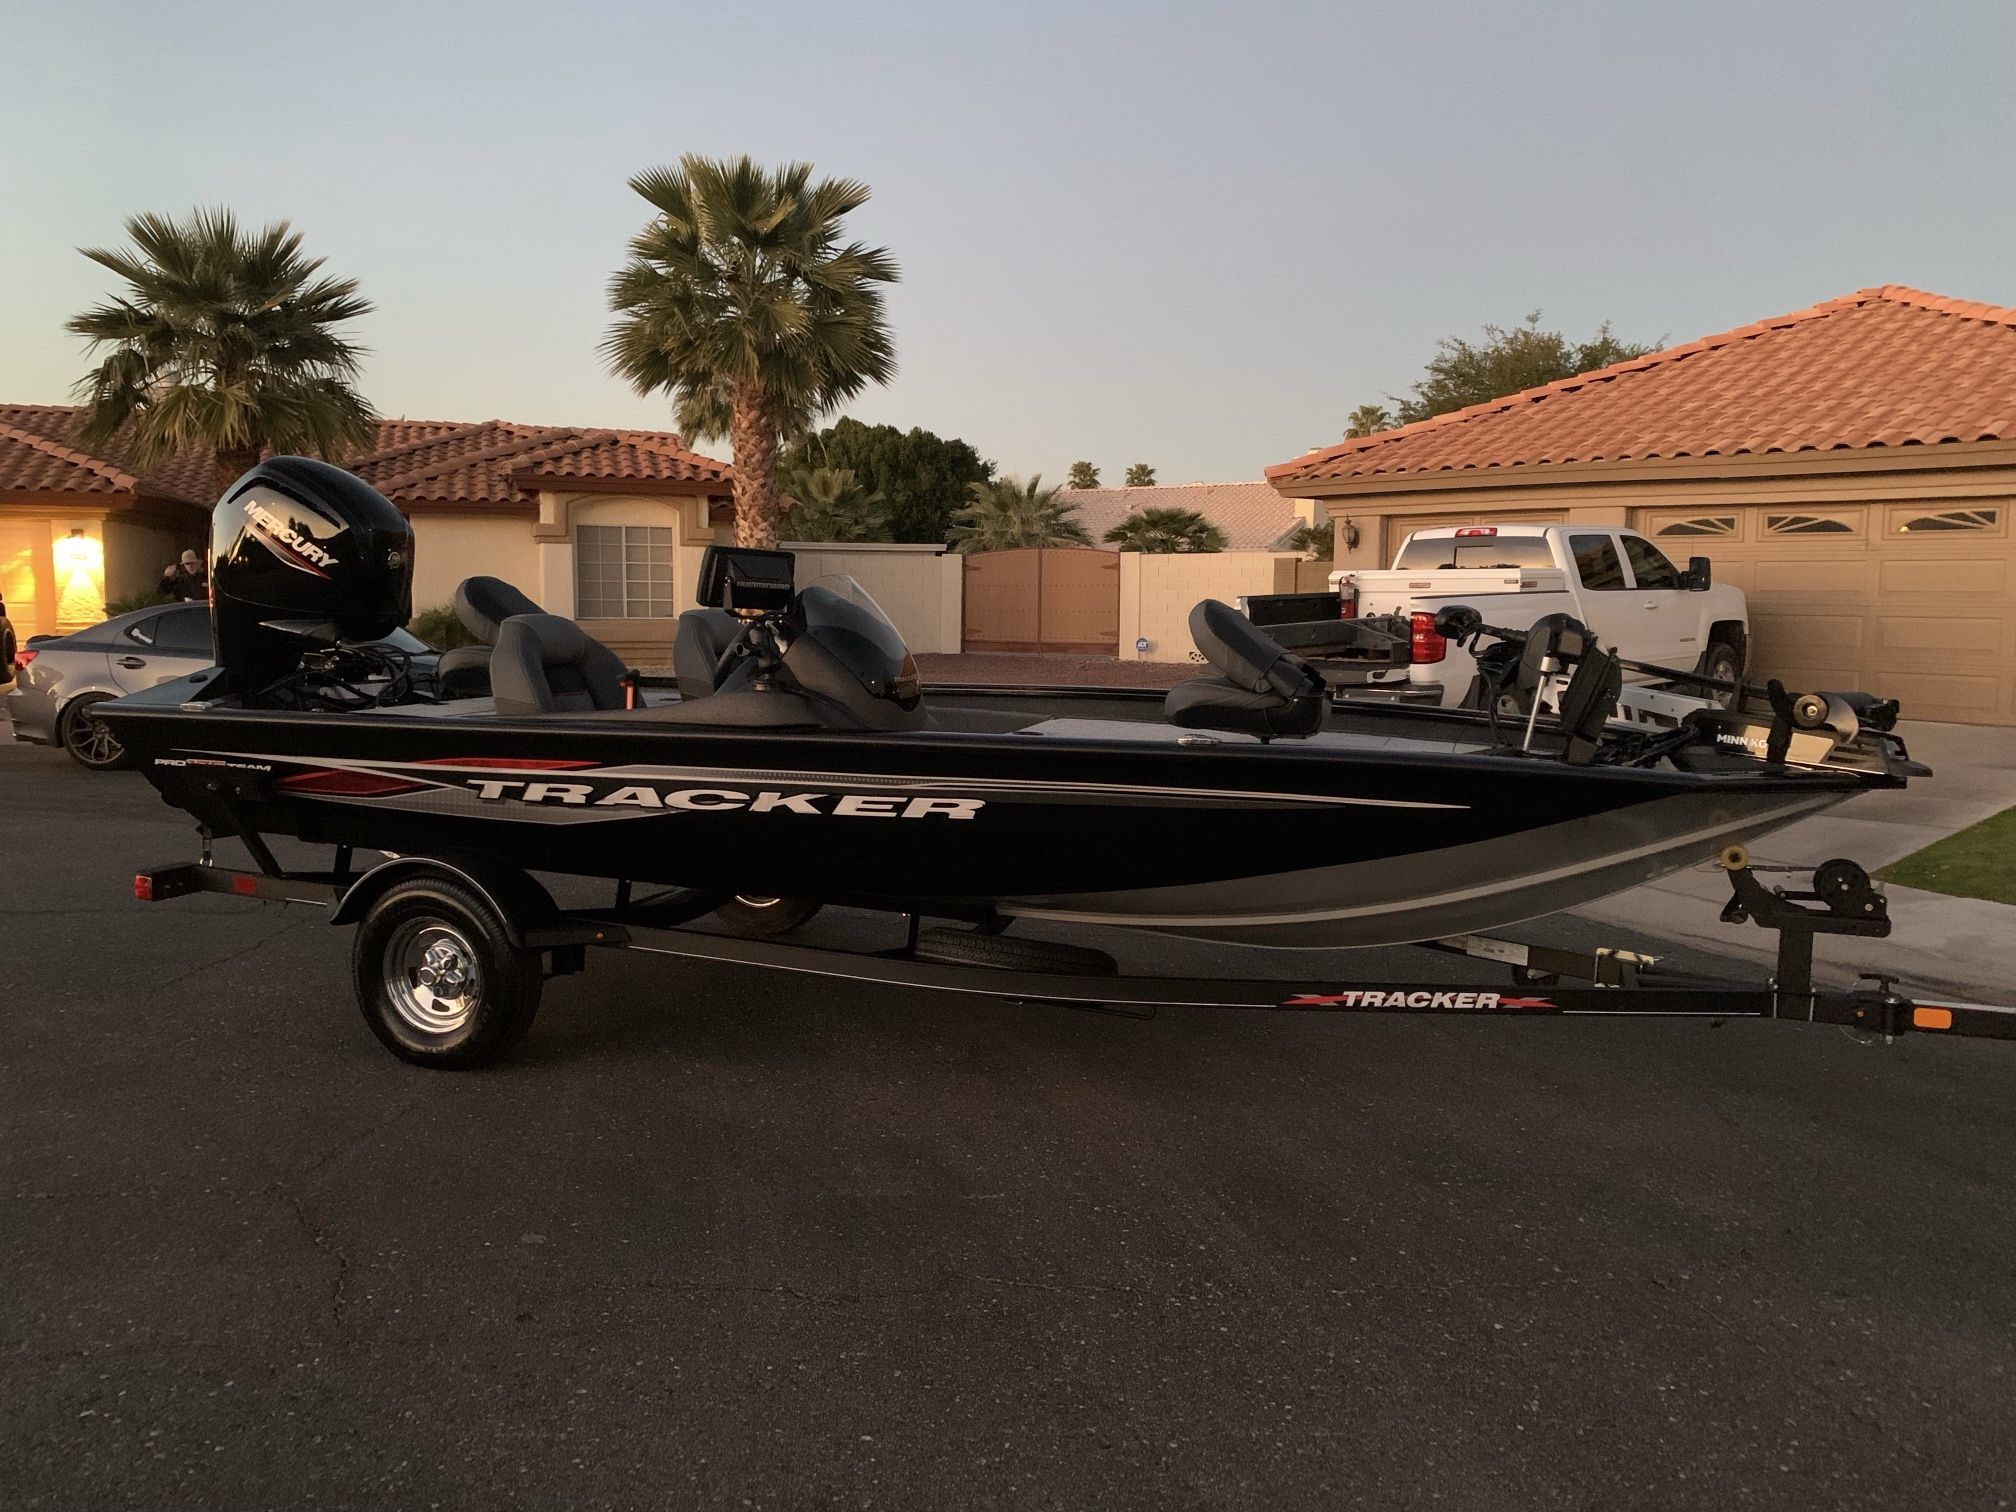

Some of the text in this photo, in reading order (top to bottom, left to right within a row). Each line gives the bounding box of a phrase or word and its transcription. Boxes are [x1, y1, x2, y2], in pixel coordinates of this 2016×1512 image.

[244, 500, 340, 567] MERCURY
[1716, 733, 1769, 749] MINN KO
[154, 758, 187, 767] PRO
[226, 763, 272, 772] TEAM
[466, 779, 986, 820] TRACKER
[1342, 991, 1501, 1009] TRACKER
